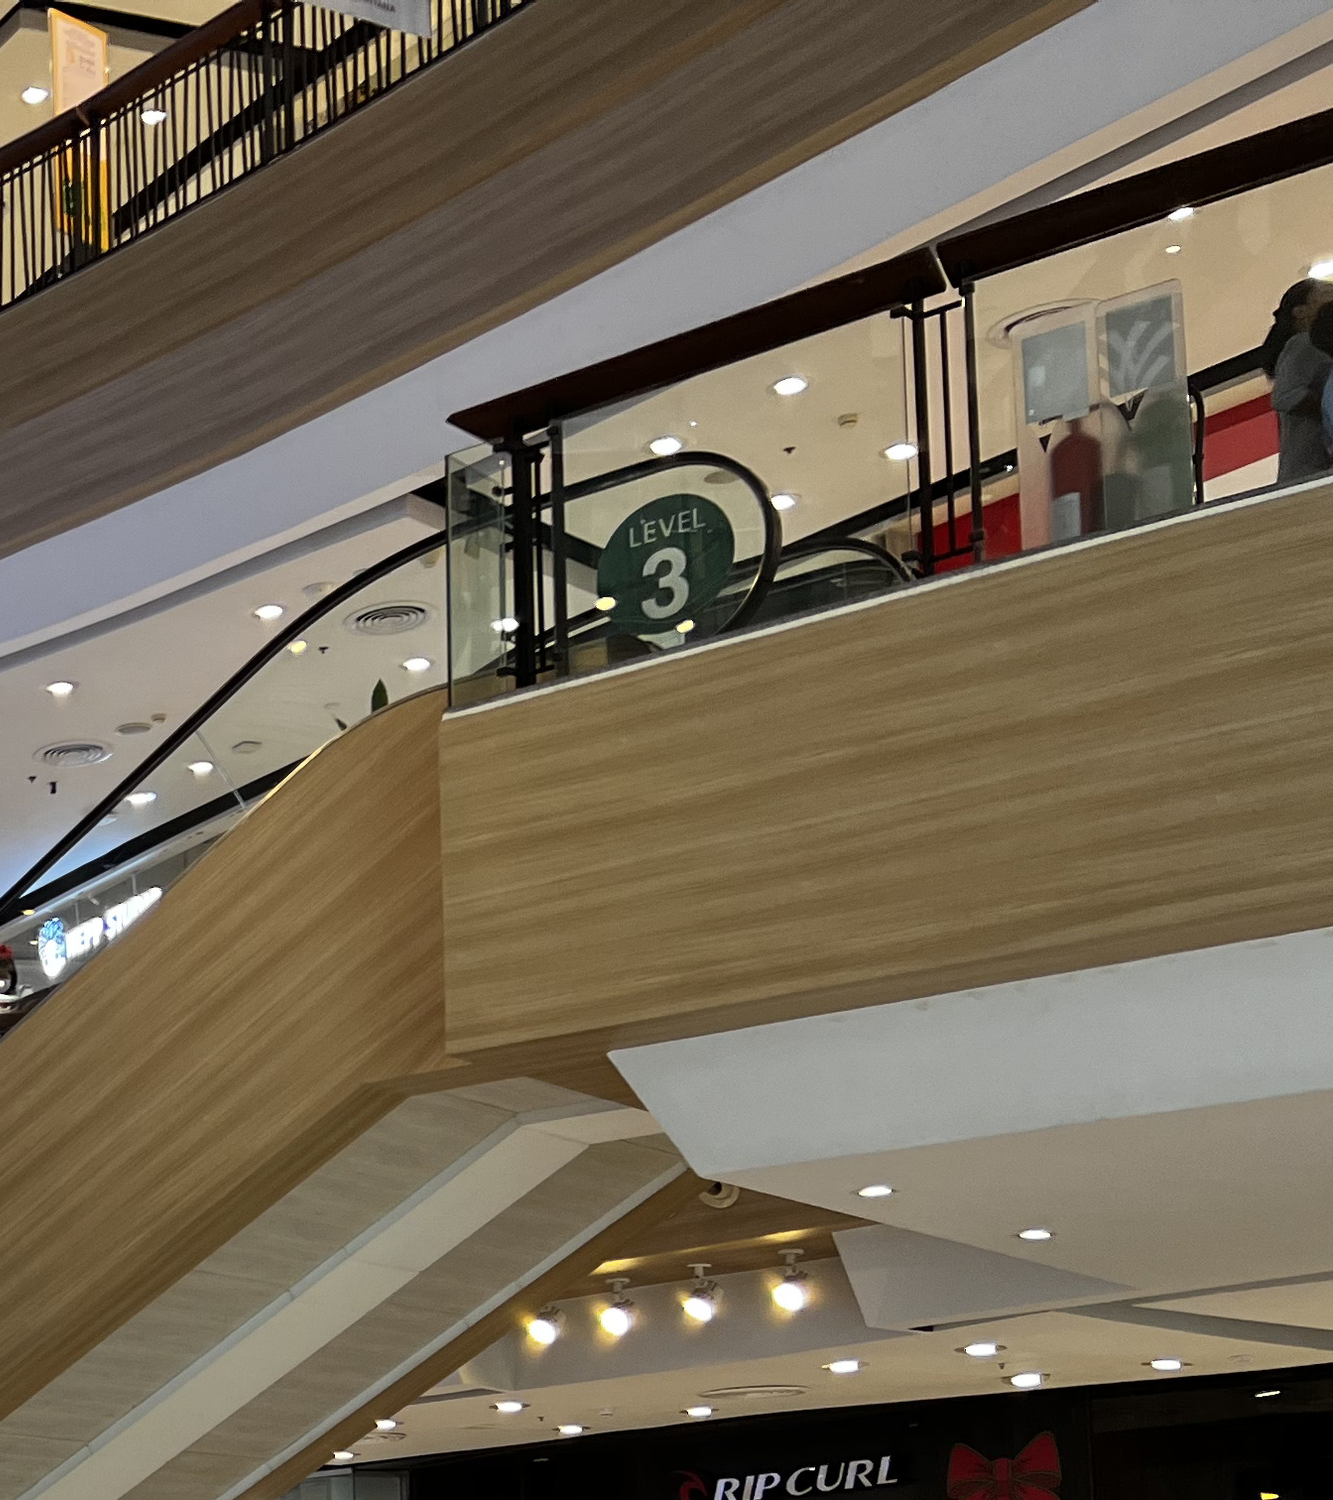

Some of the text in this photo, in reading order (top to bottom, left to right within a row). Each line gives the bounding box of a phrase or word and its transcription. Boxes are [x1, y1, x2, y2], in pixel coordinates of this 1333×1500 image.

[629, 508, 706, 548] LEVEL
[641, 547, 690, 620] 3
[785, 1456, 898, 1496] CURL
